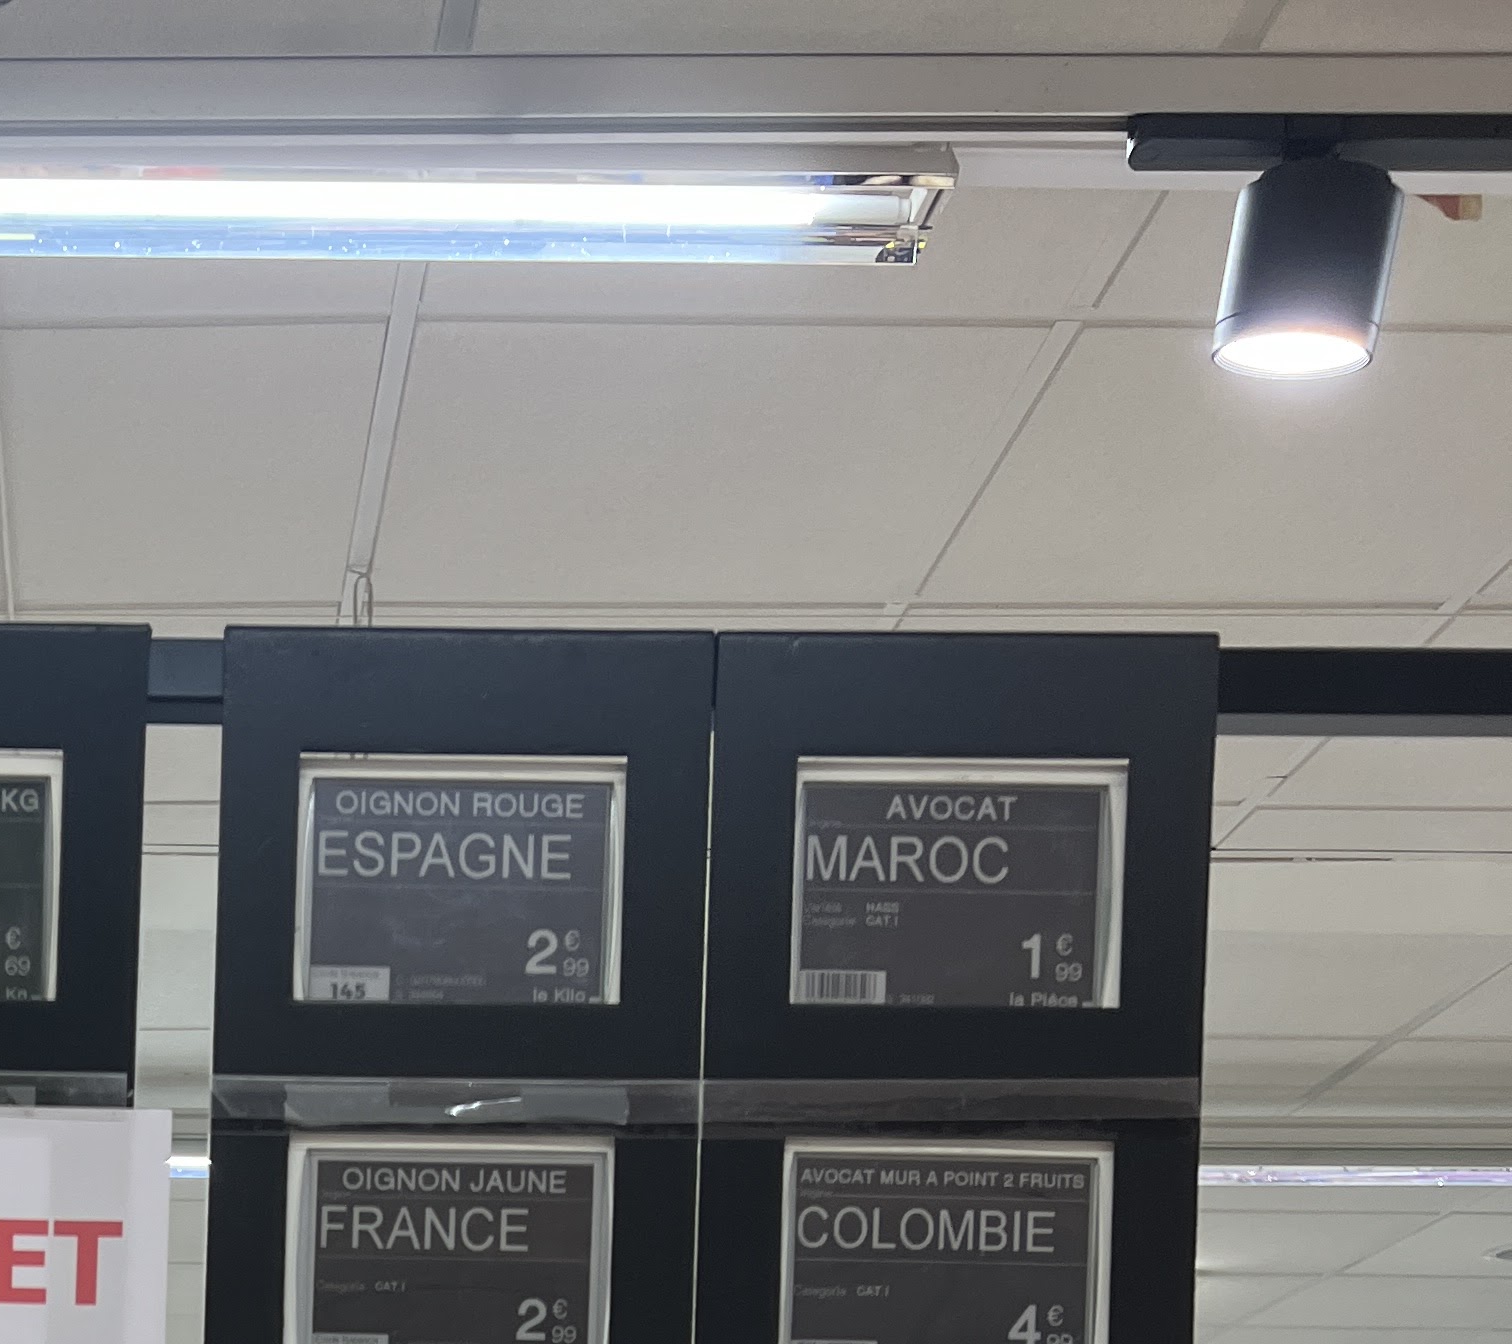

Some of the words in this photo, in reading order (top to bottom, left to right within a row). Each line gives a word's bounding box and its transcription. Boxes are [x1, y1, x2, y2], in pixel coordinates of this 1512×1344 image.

[335, 789, 460, 817] OIGNON
[473, 791, 586, 820] ROUGE
[886, 795, 1018, 823] AVOCAT
[317, 829, 572, 881] ESPAGNE
[805, 834, 1010, 885] MAROC
[4, 926, 23, 950] €
[563, 929, 580, 951] €
[1055, 933, 1074, 957] €
[524, 928, 558, 976] 2
[1021, 933, 1042, 980] 1
[4, 955, 31, 978] 69
[562, 957, 590, 978] 99
[1054, 962, 1083, 982] 99
[330, 982, 367, 1000] 145
[533, 985, 548, 1003] le
[553, 986, 586, 1003] Kilo
[1009, 992, 1026, 1008] la
[342, 1167, 460, 1193] OIGNON
[469, 1169, 567, 1195] JAUNE
[800, 1168, 876, 1186] AVOCAT
[880, 1169, 921, 1187] MUR
[925, 1171, 939, 1187] A
[944, 1171, 998, 1188] POINT
[1003, 1174, 1014, 1188] 2
[1018, 1172, 1085, 1190] FRUITS
[319, 1205, 530, 1253] FRANCE
[797, 1205, 1057, 1254] COLOMBIE
[516, 1298, 547, 1342] 2
[552, 1299, 568, 1320] €
[1046, 1304, 1064, 1327] €
[551, 1325, 577, 1344] 99
